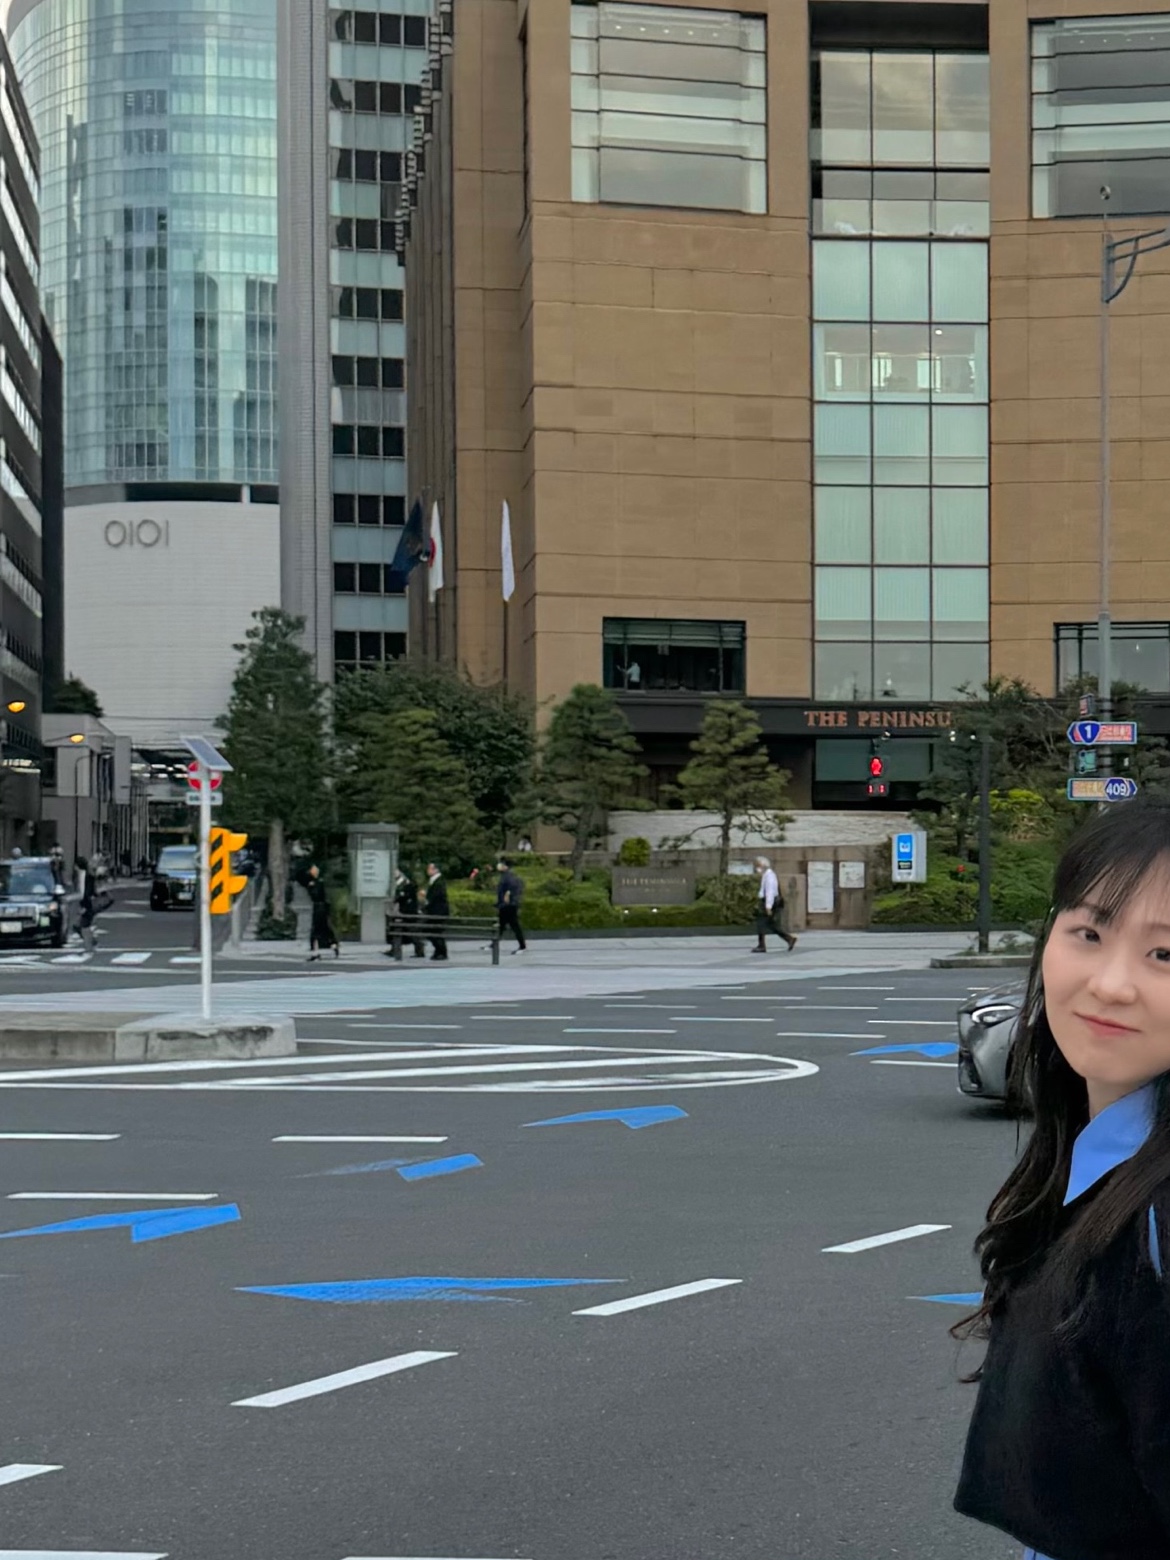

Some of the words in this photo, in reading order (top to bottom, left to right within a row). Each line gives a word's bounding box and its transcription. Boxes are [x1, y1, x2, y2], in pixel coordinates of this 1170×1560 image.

[805, 710, 848, 728] THE
[857, 710, 952, 728] PENINSU
[1084, 724, 1092, 739] 1
[1106, 783, 1127, 796] 409
